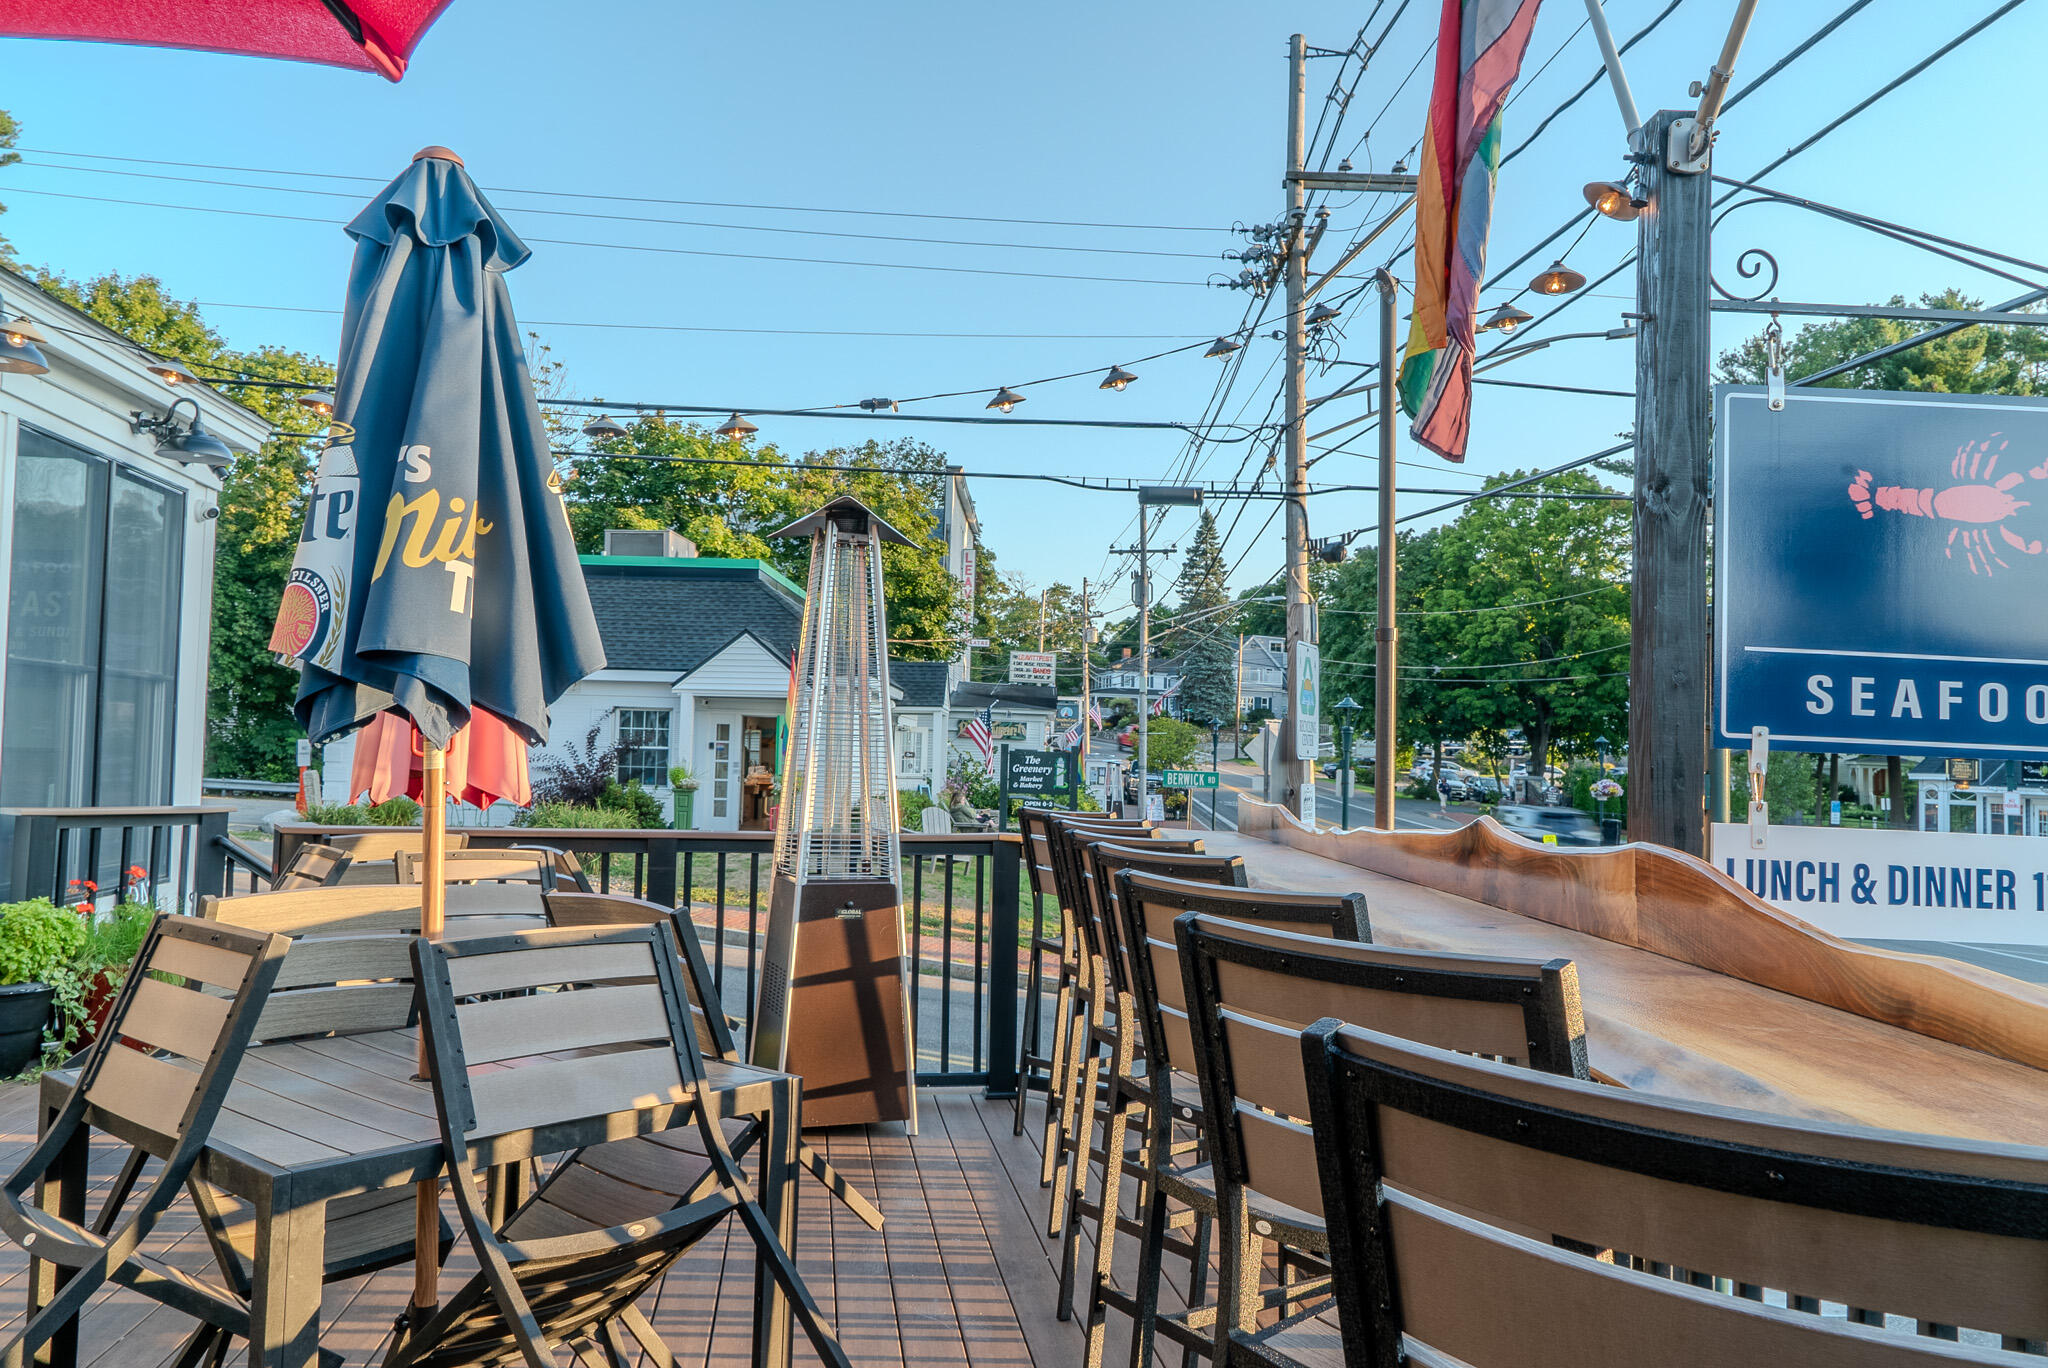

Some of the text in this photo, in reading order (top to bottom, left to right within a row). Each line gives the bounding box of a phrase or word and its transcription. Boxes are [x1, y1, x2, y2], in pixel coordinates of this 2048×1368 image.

[292, 570, 330, 613] PILSNER
[445, 559, 474, 619] T
[1025, 755, 1041, 764] The
[1012, 763, 1053, 776] Greenery
[1019, 782, 1043, 790] Bakery
[1167, 772, 1216, 786] BERWICK RD
[1851, 863, 1878, 905] &
[1888, 864, 2017, 910] DINNER
[2032, 872, 2048, 912] 1
